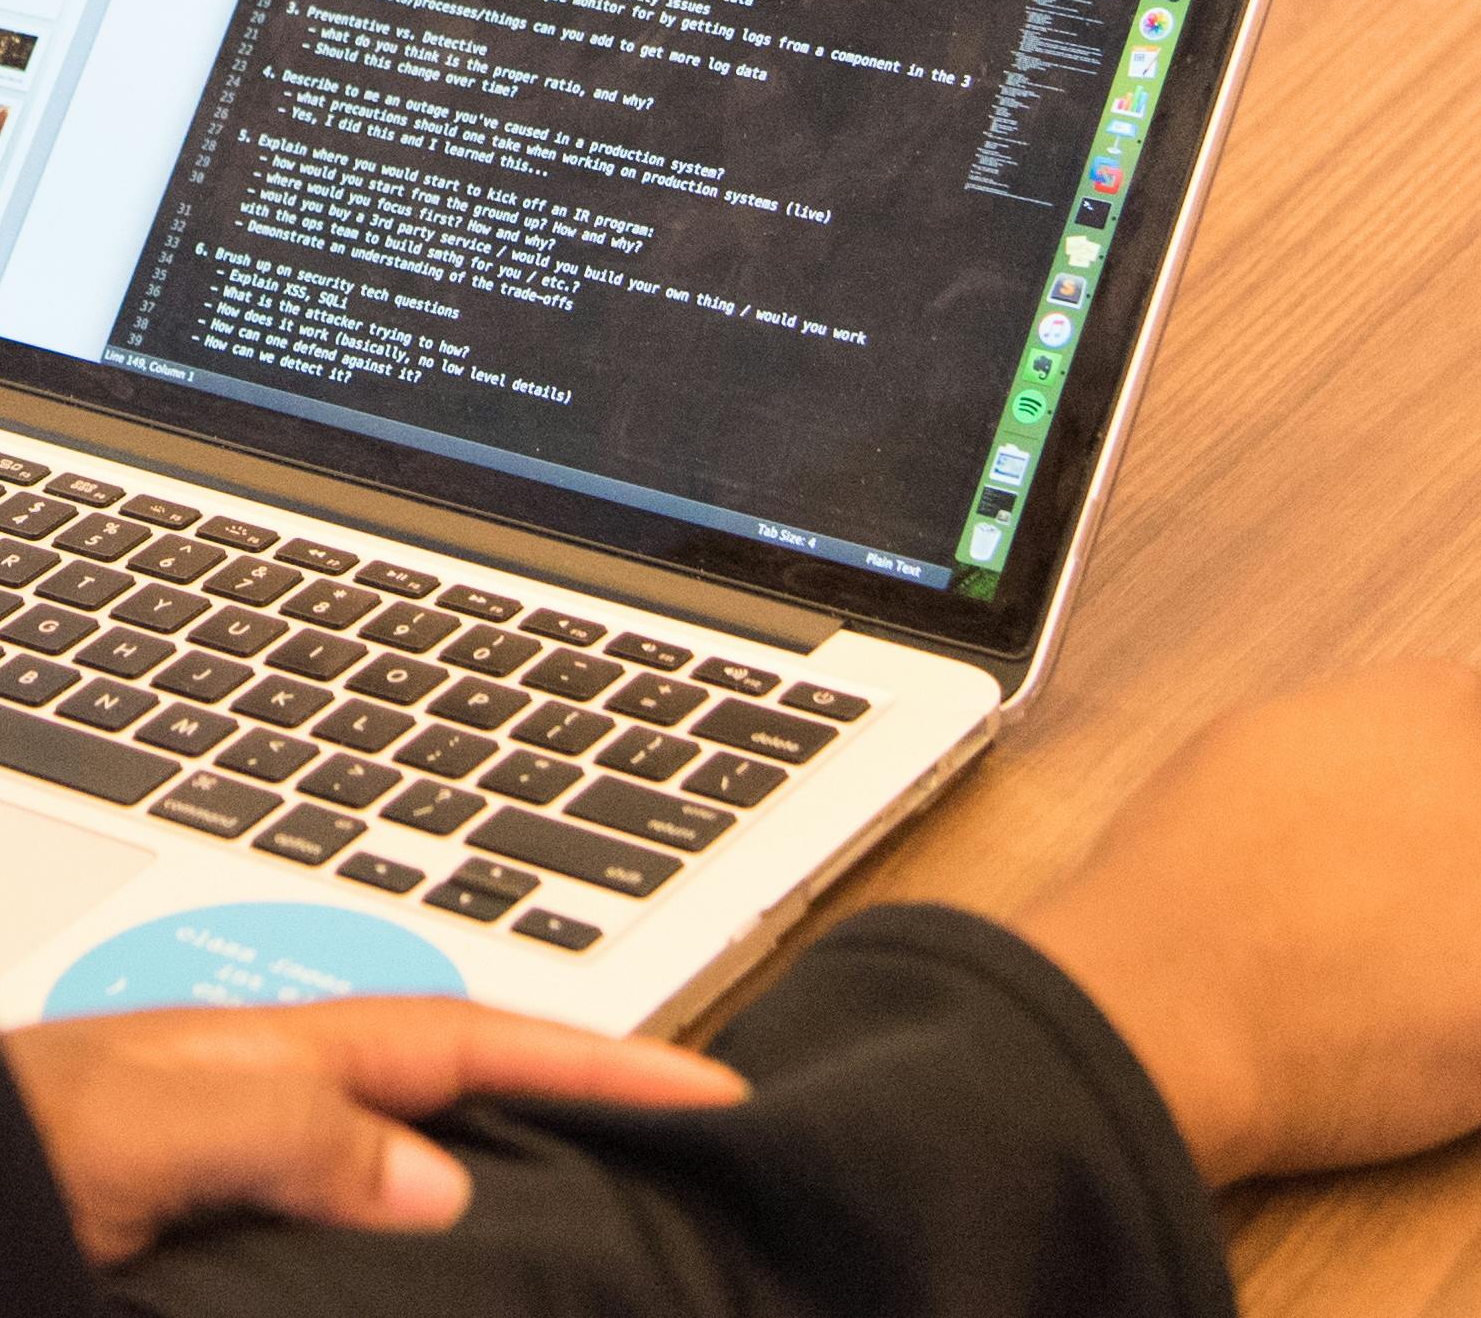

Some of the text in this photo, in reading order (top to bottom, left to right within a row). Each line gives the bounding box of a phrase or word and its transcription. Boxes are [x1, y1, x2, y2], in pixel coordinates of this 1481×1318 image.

[306, 5, 487, 56] Preventative vs. Detective
[532, 21, 555, 35] can
[559, 27, 584, 41] you
[589, 33, 614, 47] add
[619, 38, 635, 52] to
[639, 44, 663, 58] get
[668, 50, 701, 66] more
[708, 56, 730, 75] log
[735, 63, 767, 80] data
[314, 41, 518, 97] Should this change over time?
[281, 69, 725, 179] Describe to me an outage you've caused in a production system?
[292, 105, 547, 176] Yes, I did this and I learned this...
[257, 133, 653, 237] Explain where you would start to kick off an IR program:
[247, 219, 573, 310] Demonstrate an understanding of the trade-offs
[214, 246, 459, 319] Brush up on security tech questions
[229, 268, 279, 291] Explain
[282, 282, 310, 302] XSS,
[203, 334, 351, 383] How can we detect it?
[216, 301, 571, 404] How does it work (basically, no low level details)
[103, 348, 195, 382] Line 149, Column 1
[755, 522, 817, 549] Tab Size: 4
[1, 555, 20, 567] R
[864, 551, 924, 578] Plain Text
[78, 576, 95, 588] T
[154, 599, 172, 611] Y
[39, 620, 59, 632] G
[228, 622, 250, 635] U
[113, 643, 137, 657] H
[19, 671, 38, 684] B
[193, 669, 211, 680] J
[387, 670, 408, 682] O
[95, 694, 119, 709] N
[272, 692, 293, 706] K
[468, 693, 489, 705] P
[171, 719, 198, 735] M
[353, 716, 367, 731] L
